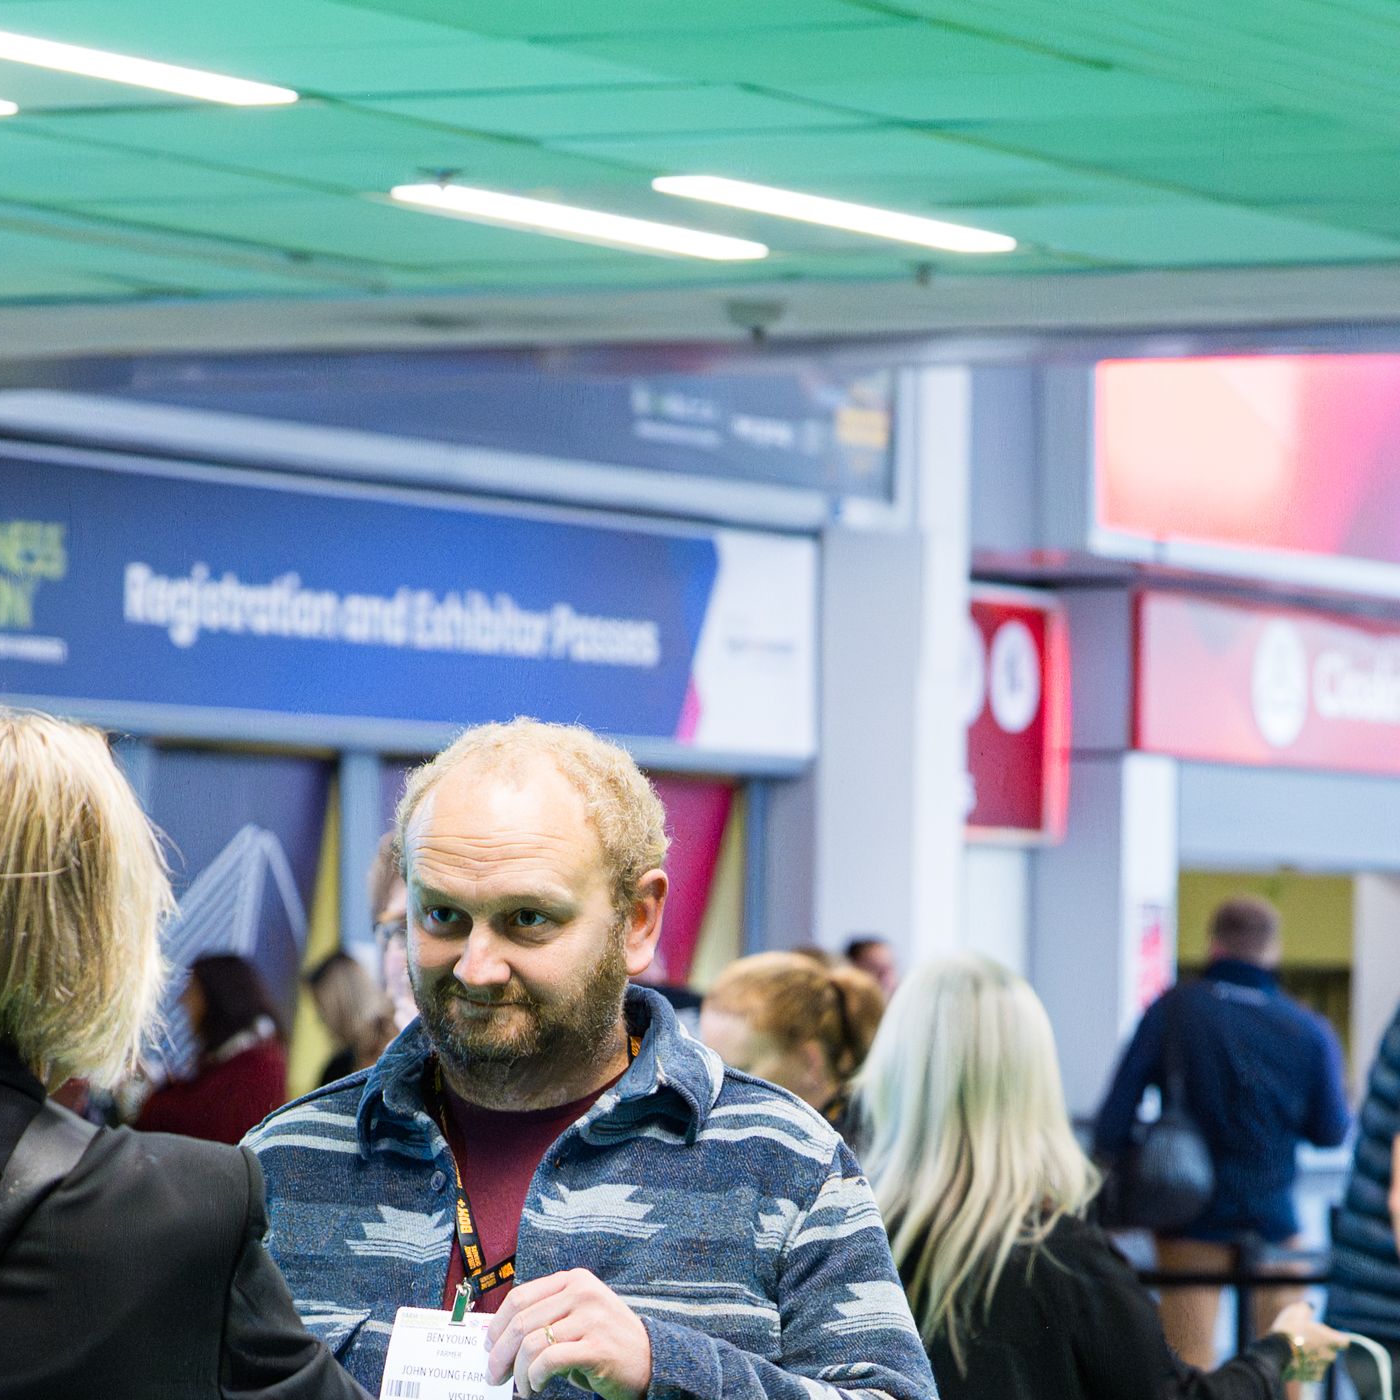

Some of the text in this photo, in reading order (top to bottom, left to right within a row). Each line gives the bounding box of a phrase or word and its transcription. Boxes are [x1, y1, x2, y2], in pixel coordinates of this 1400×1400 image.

[123, 561, 339, 649] Registration
[426, 1332, 478, 1346] BEN YOUNG
[402, 1365, 427, 1377] JOHN
[428, 1367, 460, 1381] YOUNG
